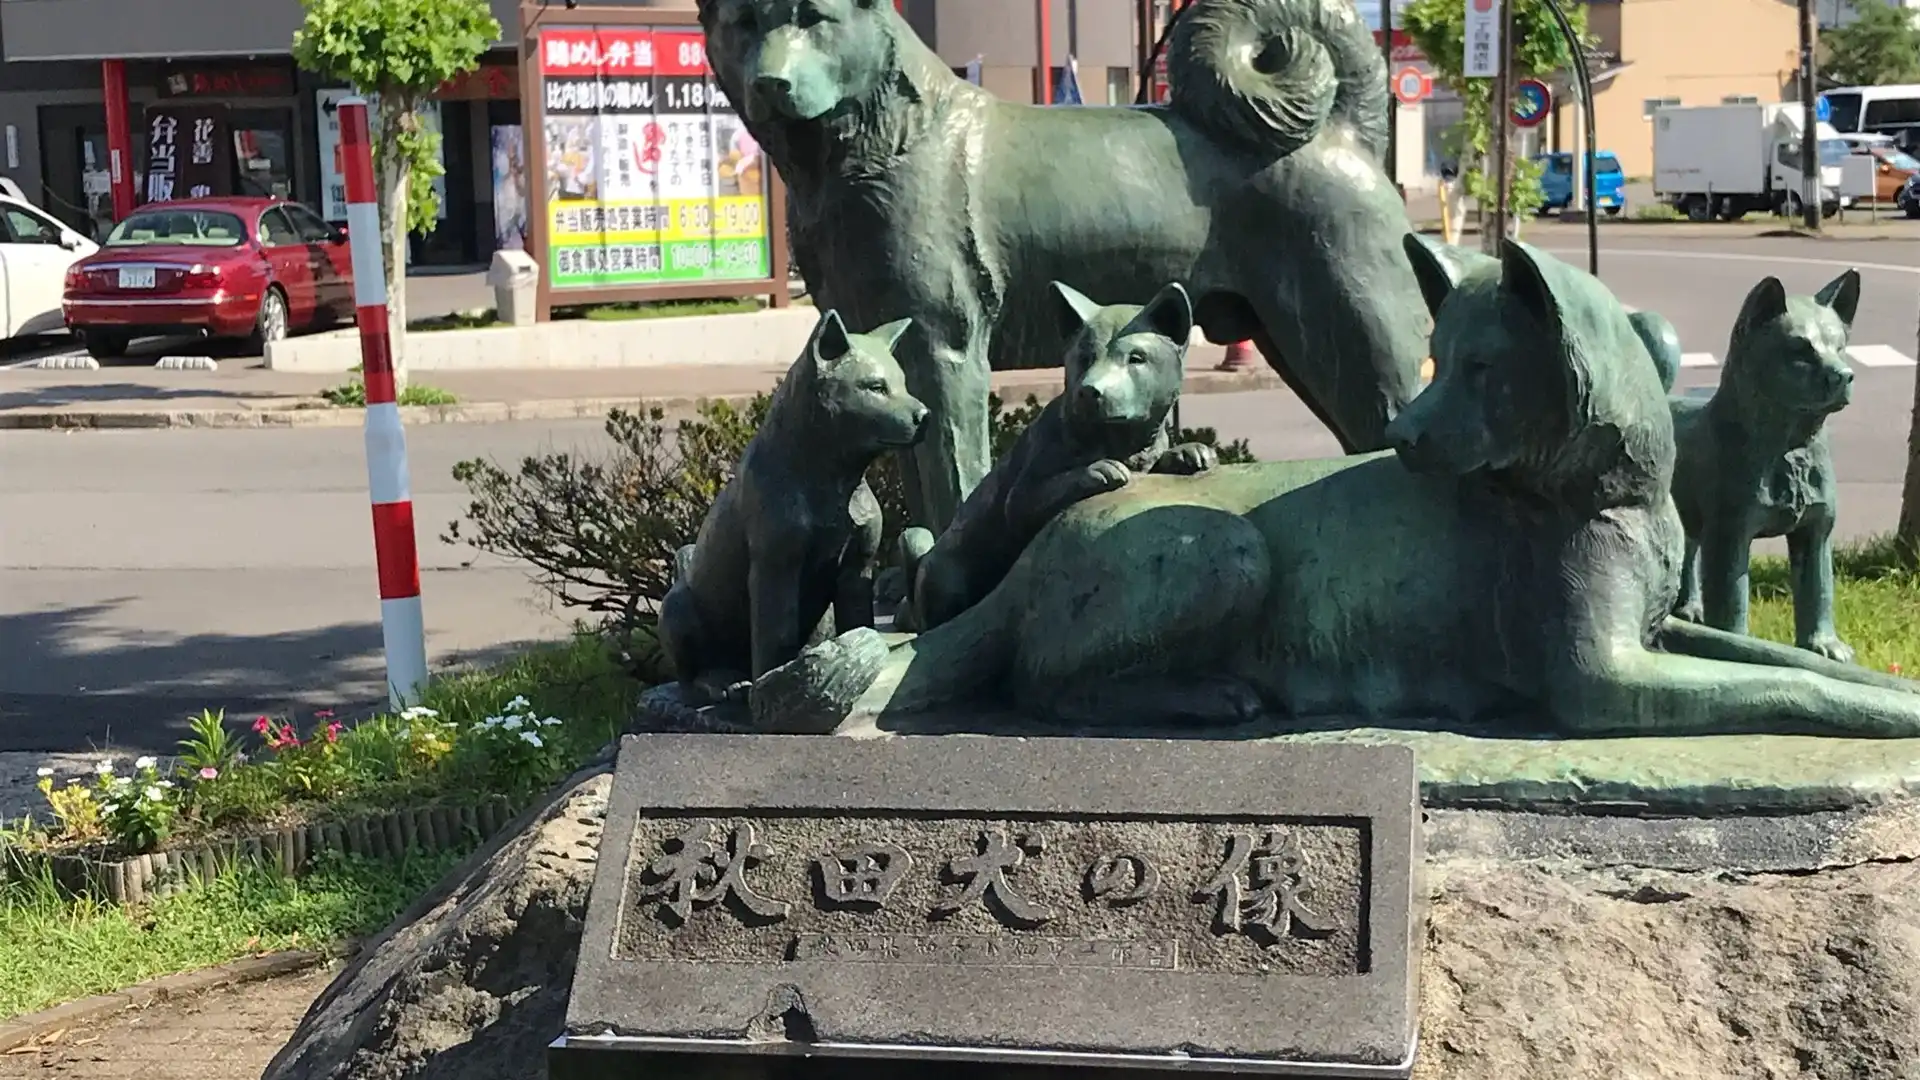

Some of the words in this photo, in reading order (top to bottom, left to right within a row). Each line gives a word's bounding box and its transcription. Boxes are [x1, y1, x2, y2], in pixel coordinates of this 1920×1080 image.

[546, 41, 654, 67] 鶏めし弁当
[678, 42, 706, 66] 88
[640, 822, 1336, 946] 秋田犬の像
